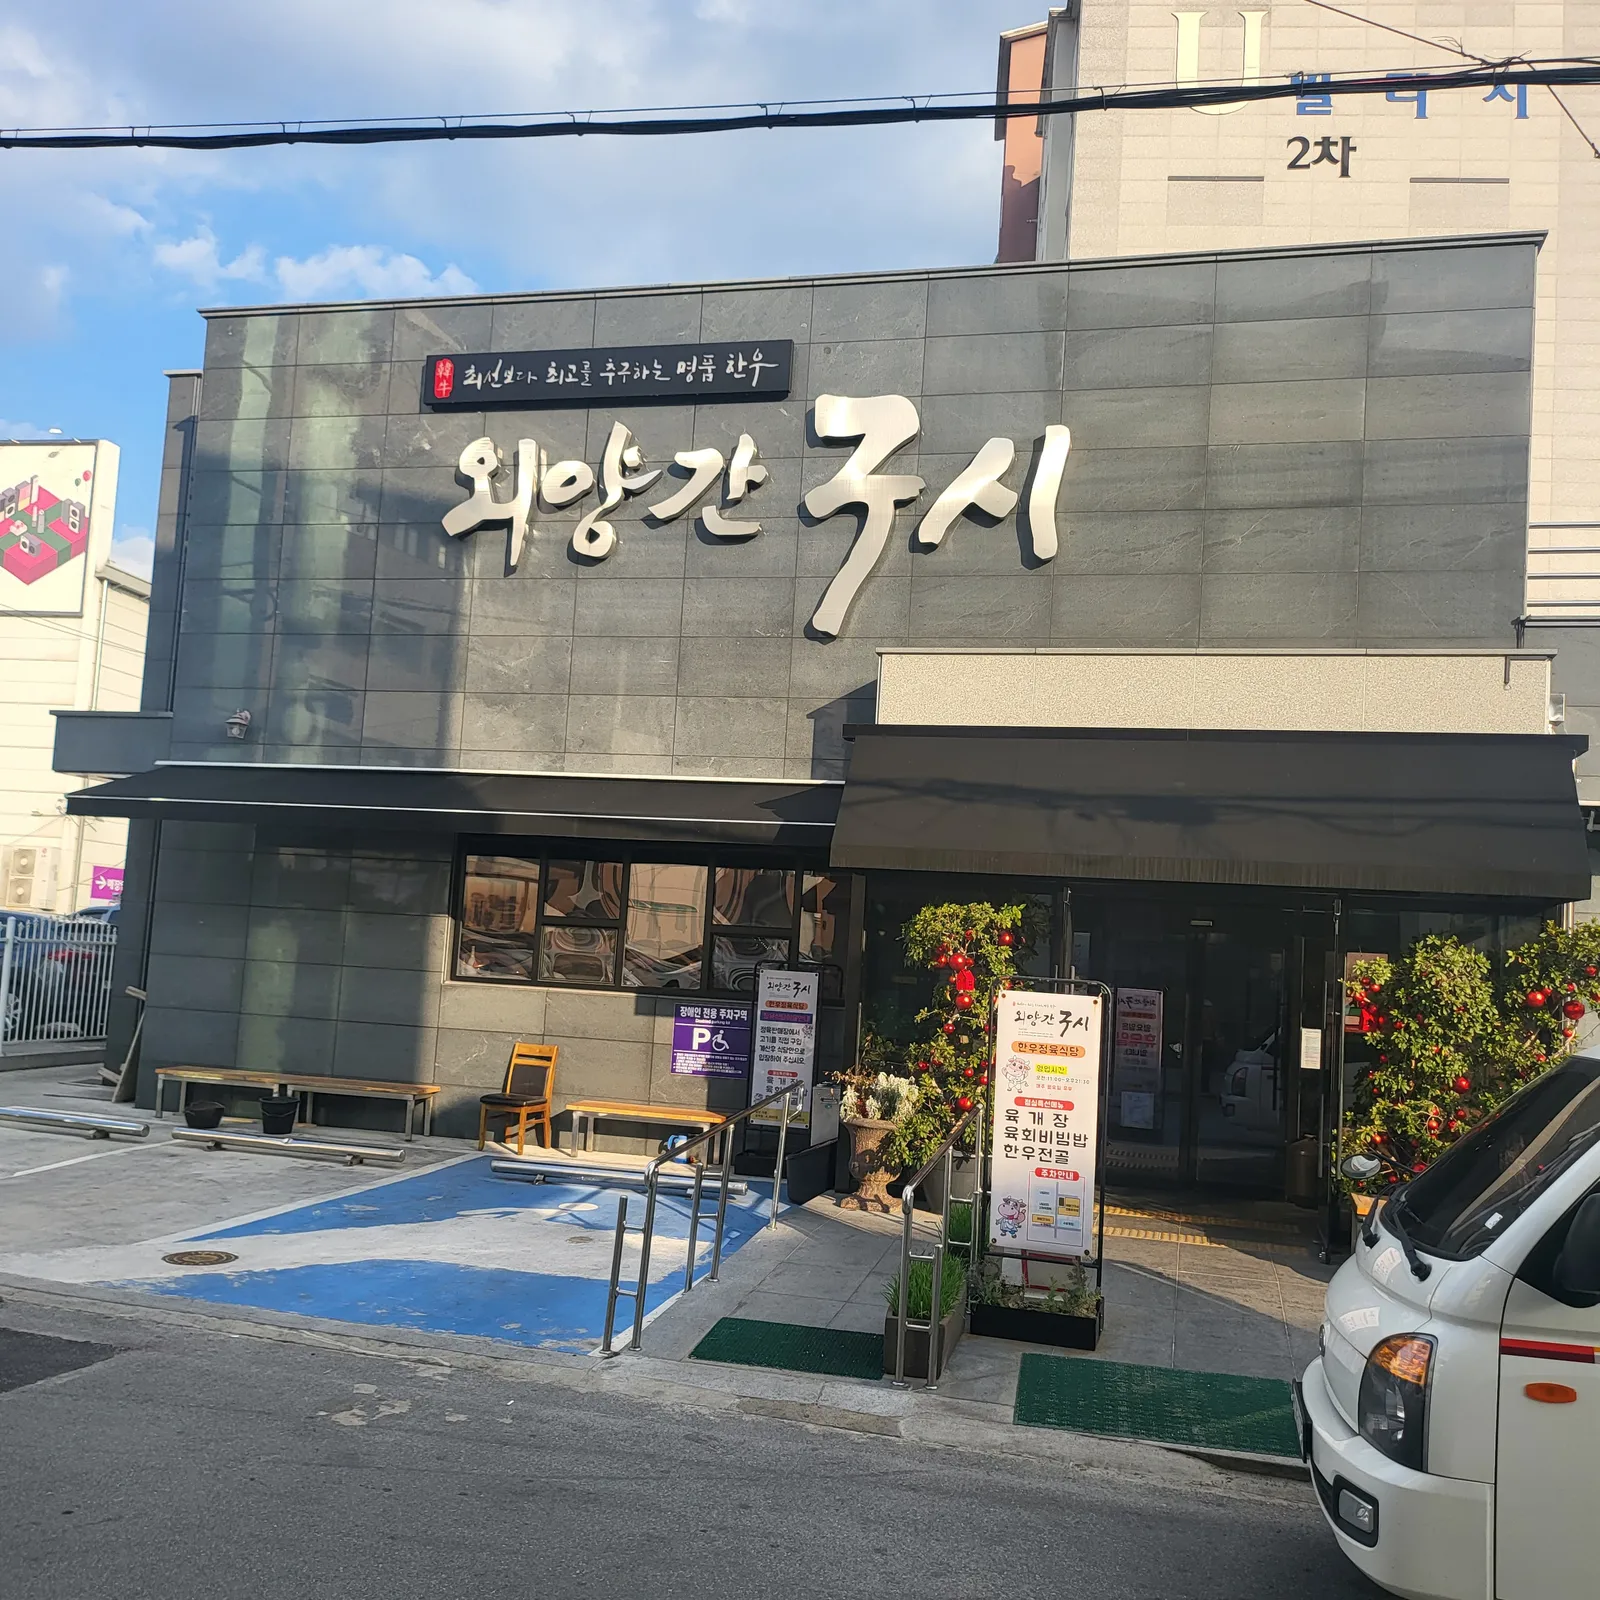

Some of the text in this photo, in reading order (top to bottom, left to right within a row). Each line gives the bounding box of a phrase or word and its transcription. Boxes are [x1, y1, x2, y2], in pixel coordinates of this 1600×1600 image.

[1287, 136, 1357, 178] 2차
[463, 348, 780, 390] 최선보다 최고를 추구하는 명품 한우
[680, 1006, 748, 1021] 장애인 전용 주차구역
[692, 1027, 711, 1050] P
[1017, 1042, 1079, 1057] 한우정육식당
[1036, 1064, 1065, 1075] 영업시간
[1004, 1126, 1088, 1148] 육회비빔밥
[1003, 1143, 1069, 1165] 한우전골
[1040, 1168, 1074, 1180] 주차안내
